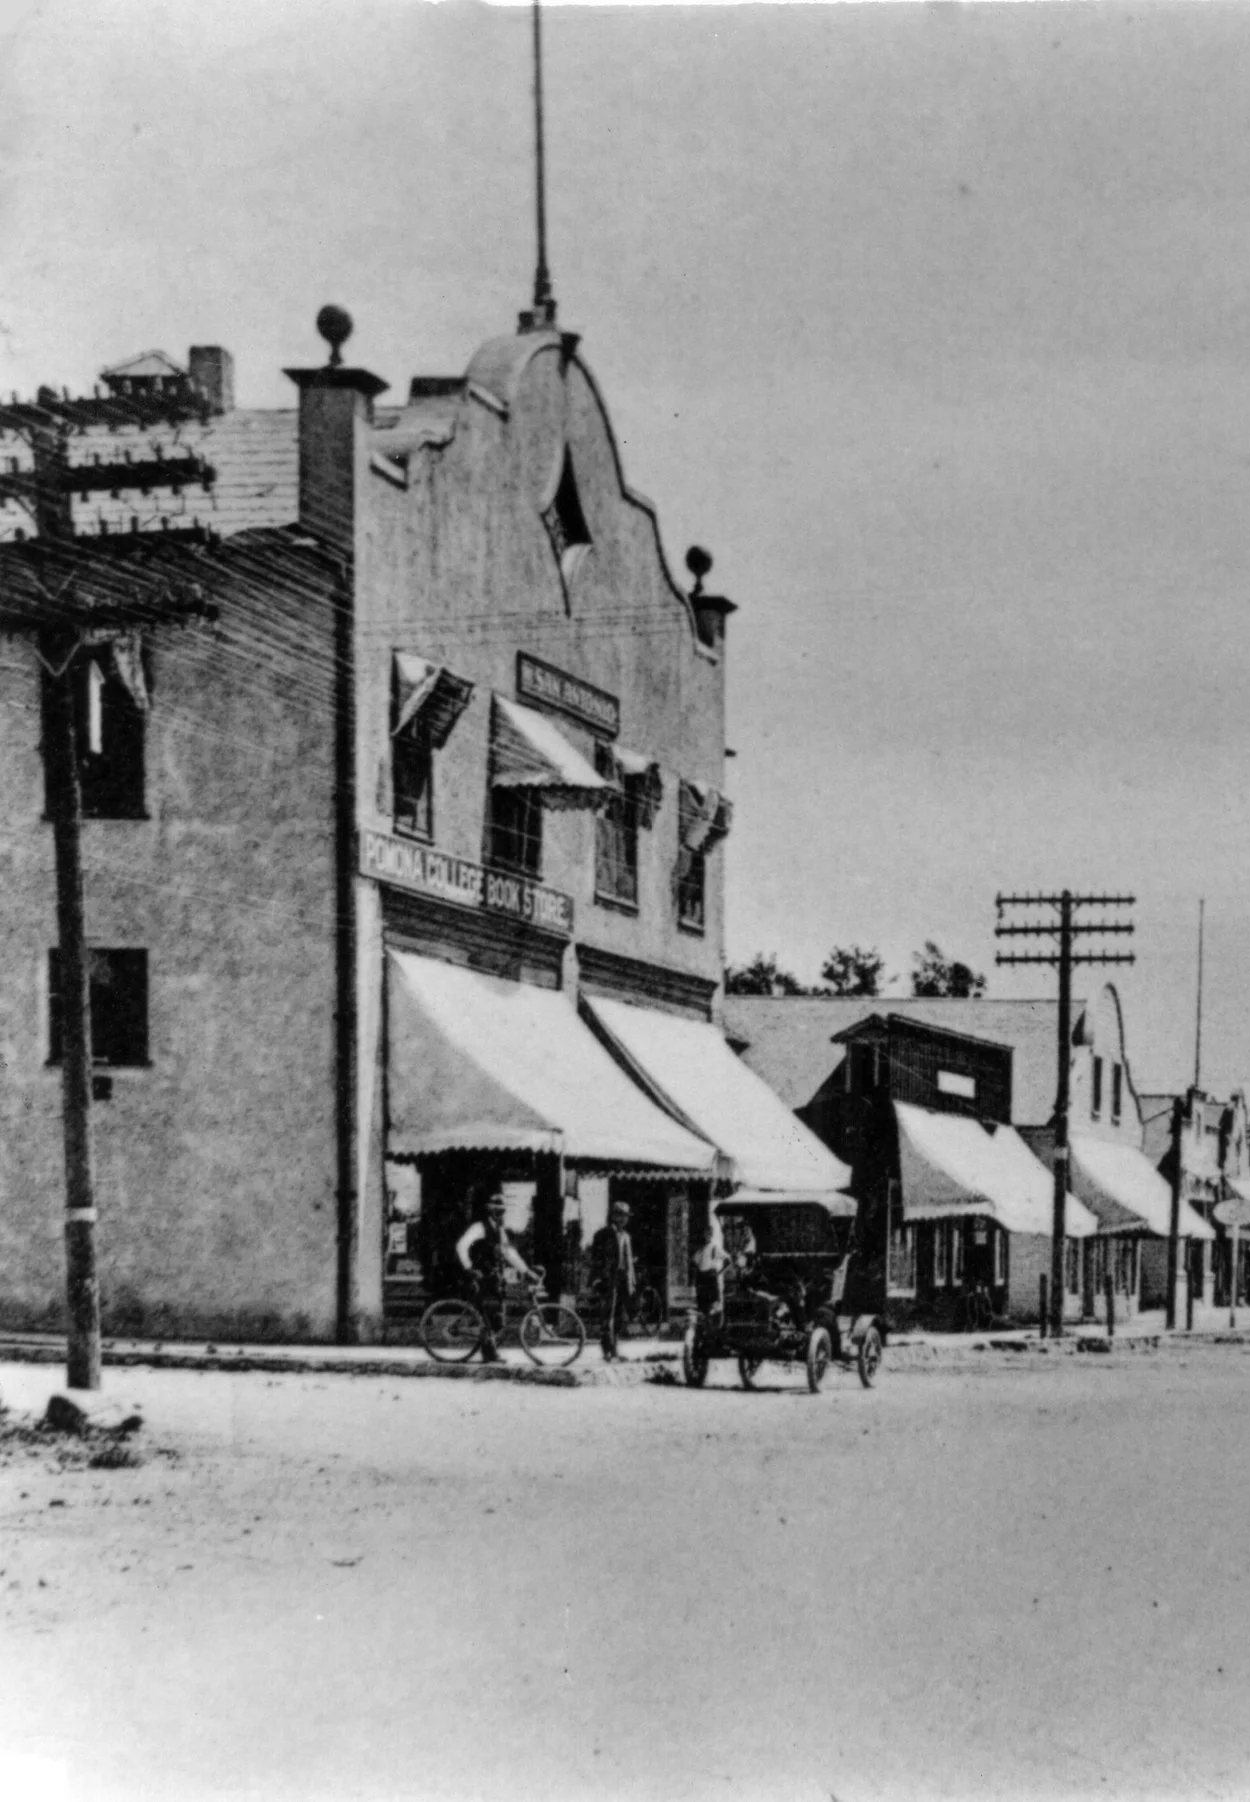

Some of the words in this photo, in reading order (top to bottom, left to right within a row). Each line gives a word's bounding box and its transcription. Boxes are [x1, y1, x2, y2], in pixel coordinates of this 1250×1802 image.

[365, 832, 424, 884] POMONA
[426, 852, 484, 902] COLLEGE
[487, 873, 521, 911] BOOK
[523, 884, 570, 928] STORE
